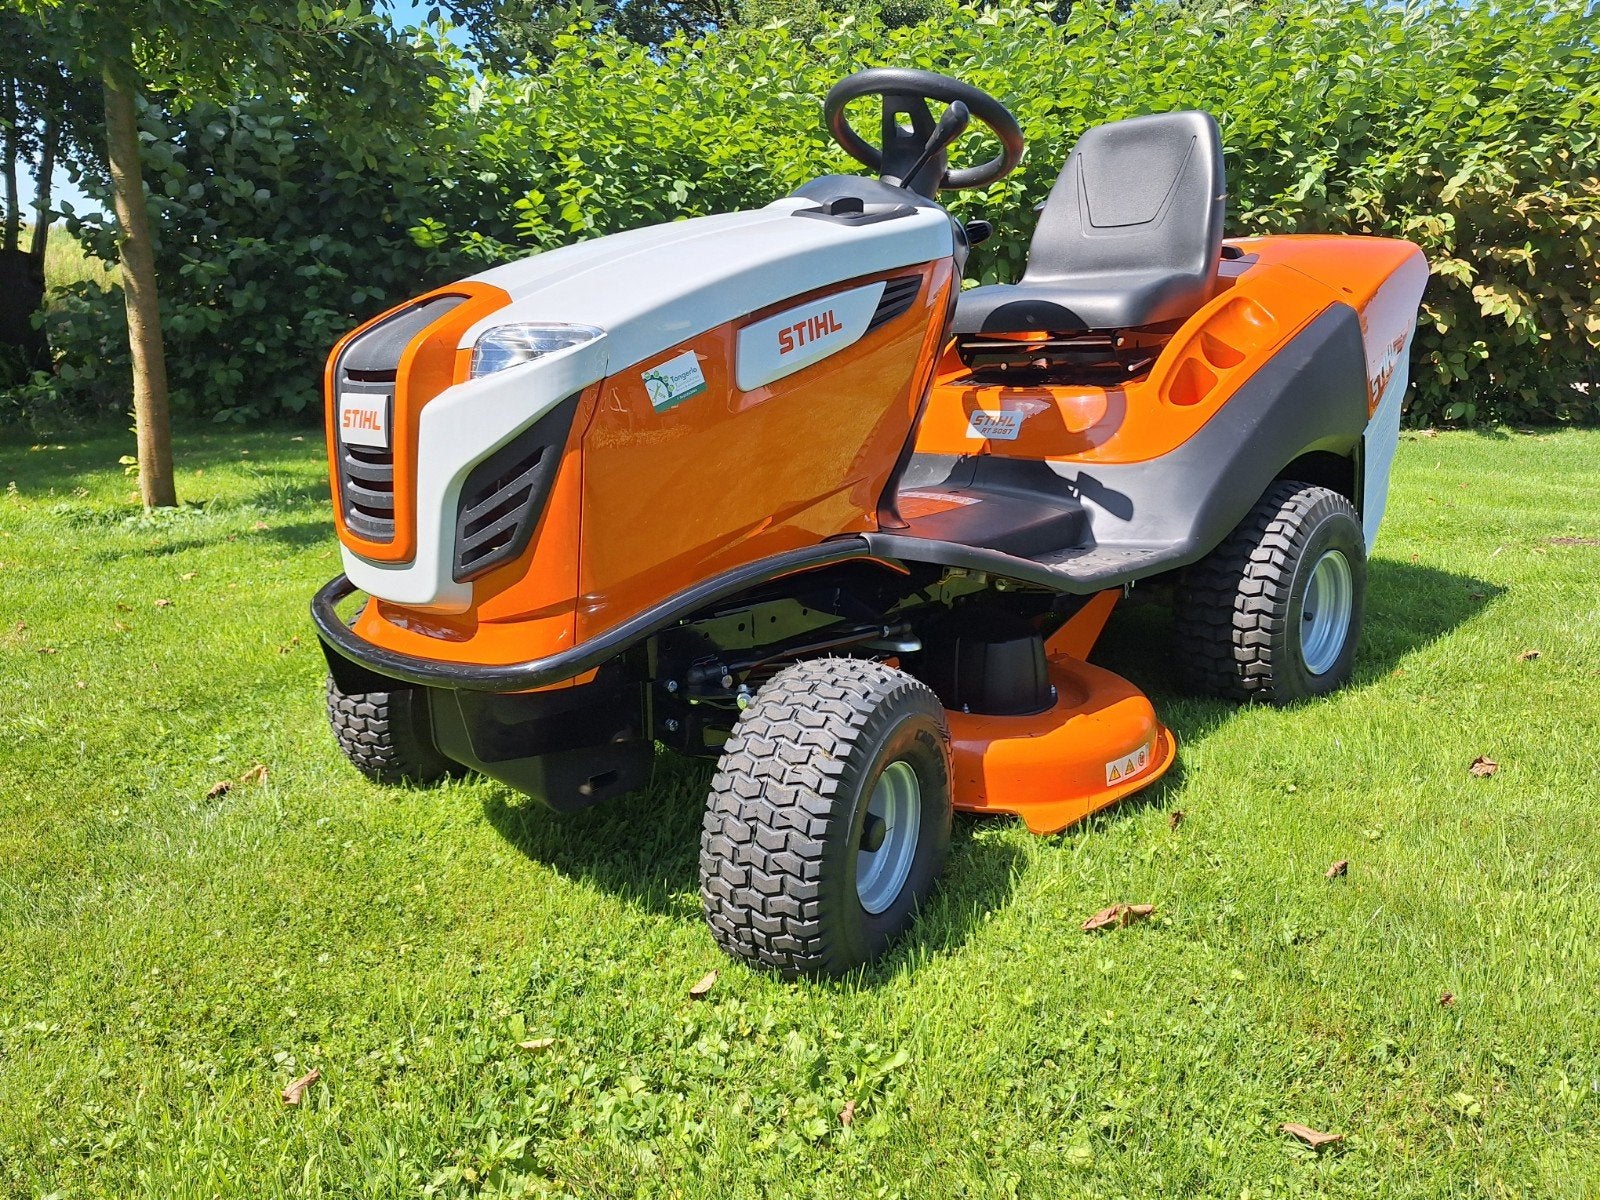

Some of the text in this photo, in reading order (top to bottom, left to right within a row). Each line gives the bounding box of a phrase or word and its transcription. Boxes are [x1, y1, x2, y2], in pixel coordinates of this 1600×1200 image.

[778, 310, 843, 355] STIHL
[669, 366, 699, 384] Tongerlo
[342, 409, 382, 431] STIHL
[973, 415, 1016, 427] STIHL
